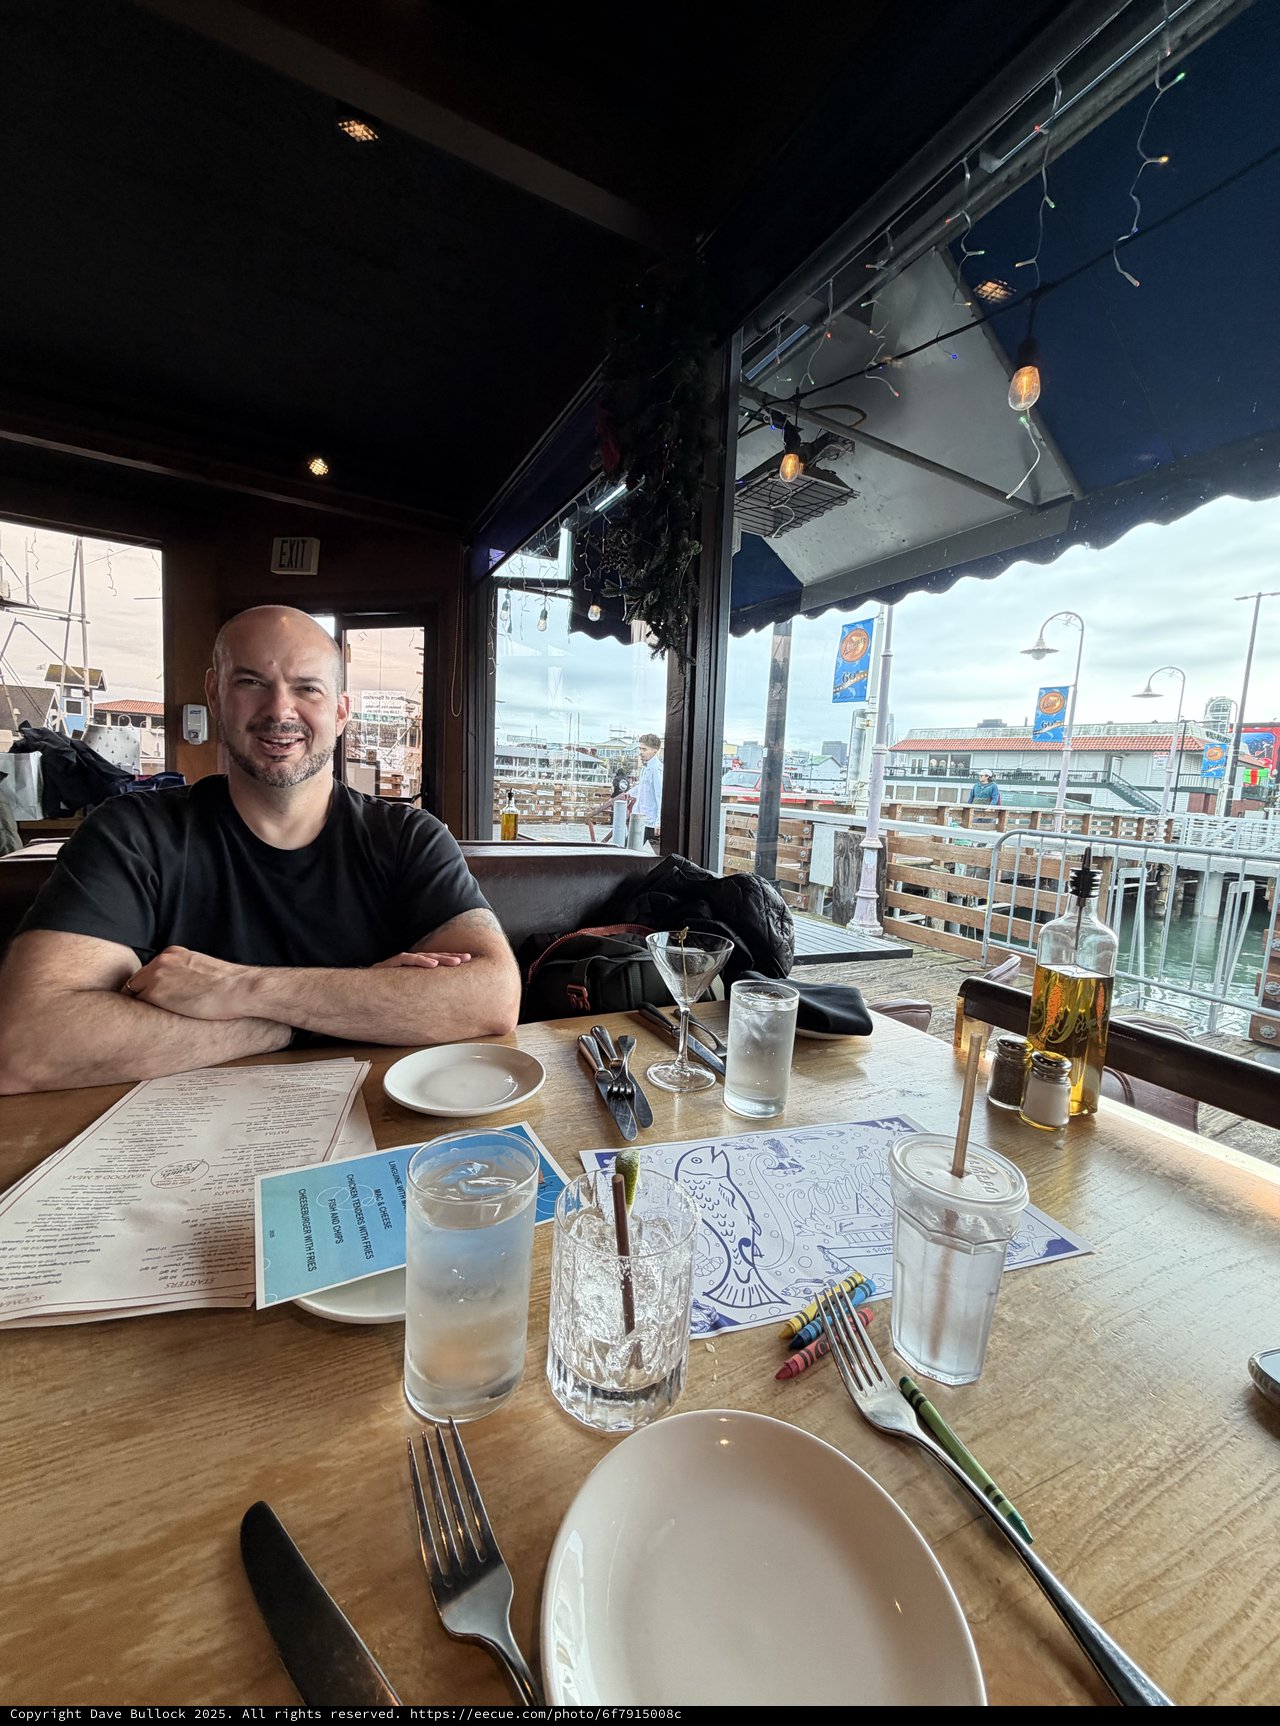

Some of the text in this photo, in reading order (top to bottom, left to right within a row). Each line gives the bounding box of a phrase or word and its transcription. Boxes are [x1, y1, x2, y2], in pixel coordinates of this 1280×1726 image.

[279, 540, 307, 569] EXIT
[389, 1160, 403, 1185] LINGUINE
[374, 1188, 385, 1201] MAC
[298, 1188, 317, 1272] CHEESEBURGER WITH FRIES
[328, 1198, 344, 1245] FISH AND CHIPS
[346, 1174, 375, 1260] CHICKEN TENDERS WITH FRIES
[379, 1206, 393, 1230] CHEESE
[165, 1278, 217, 1290] STARTERS
